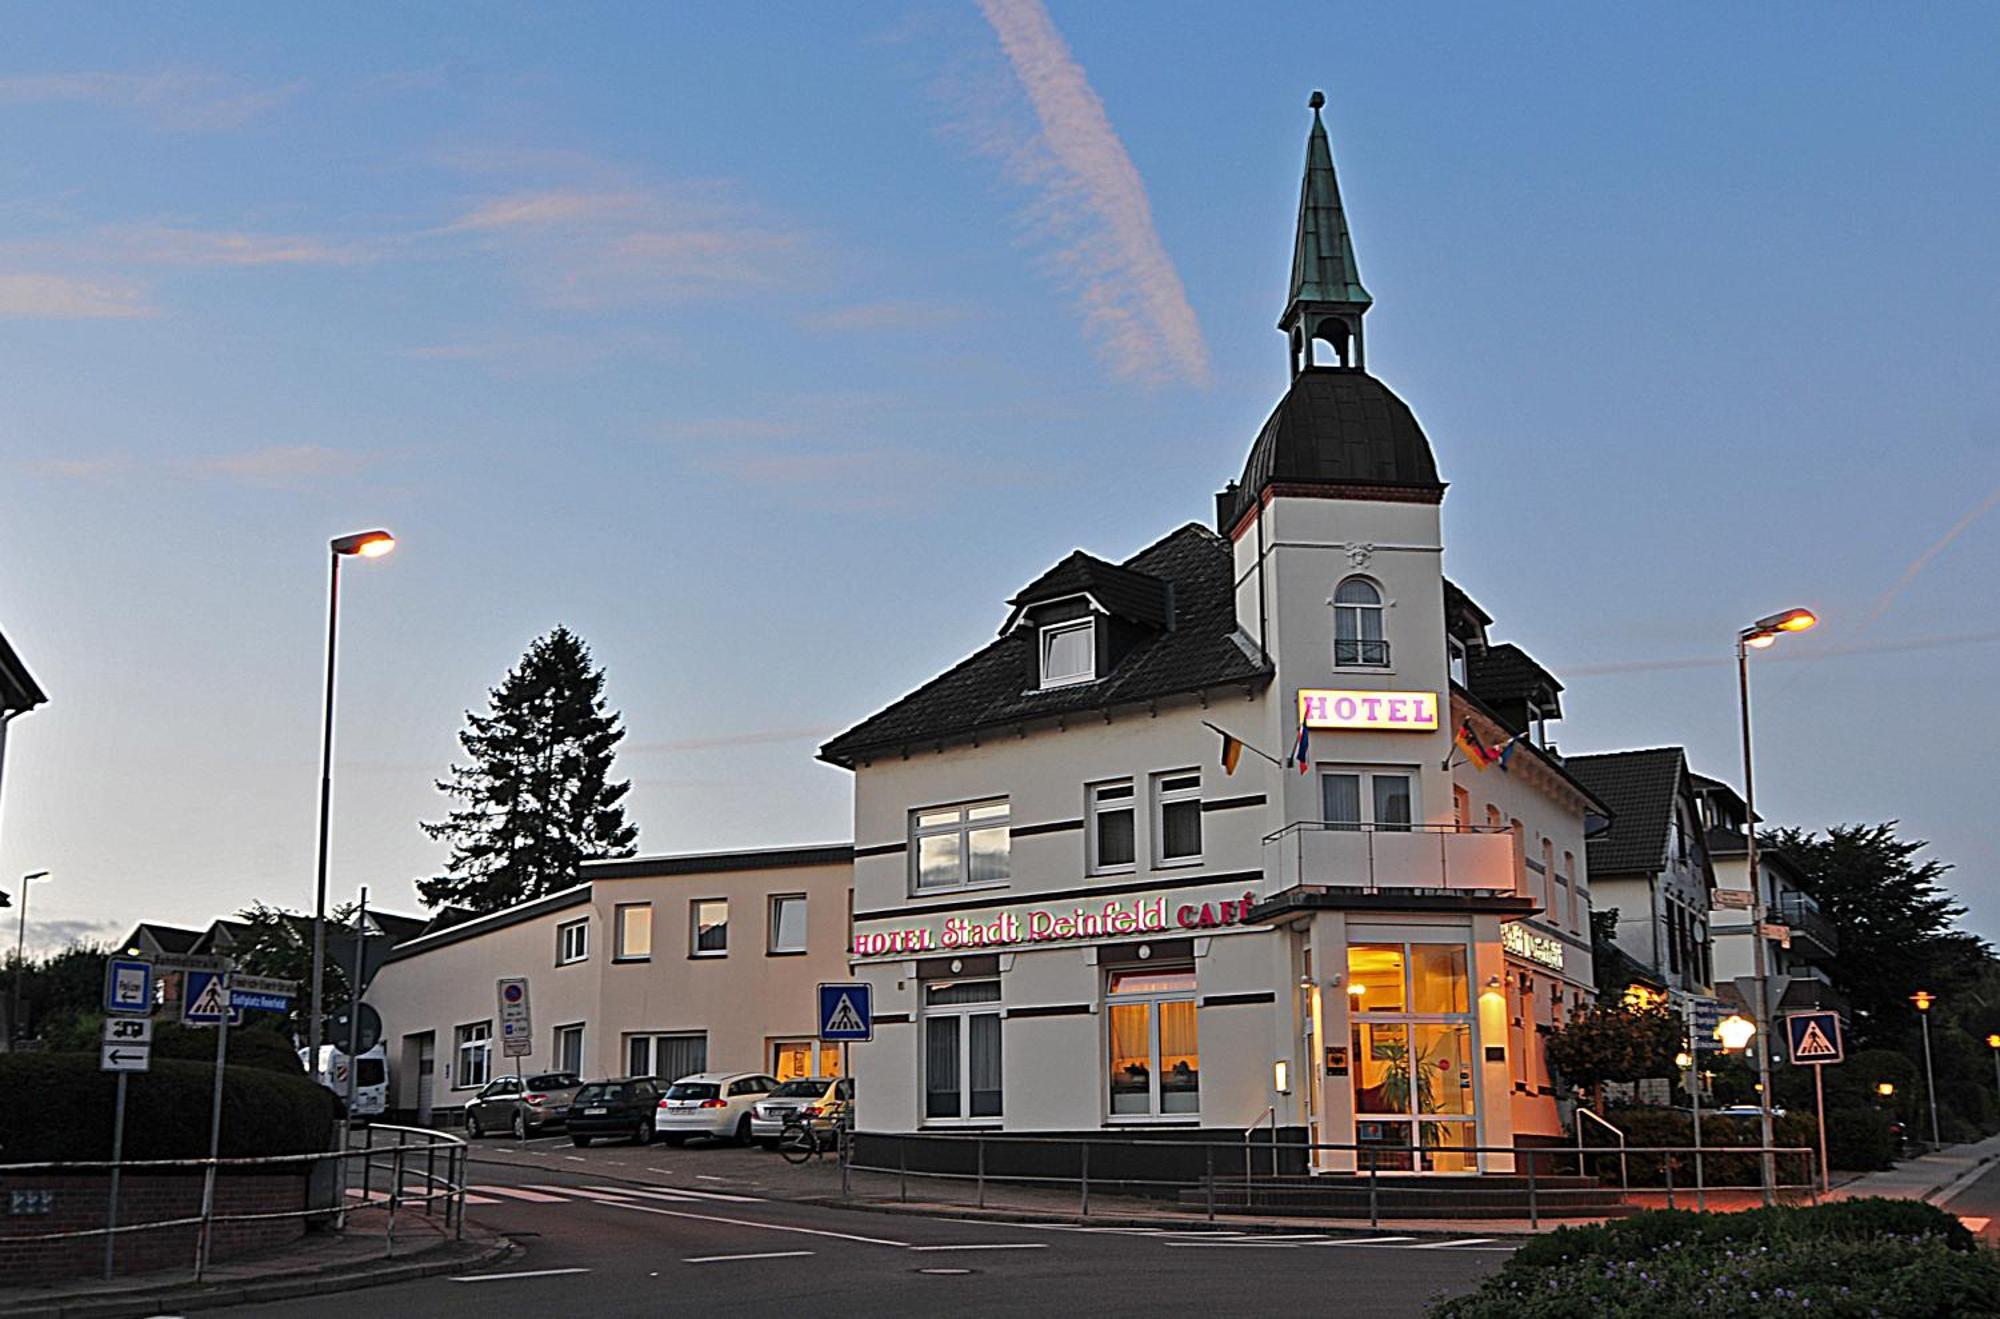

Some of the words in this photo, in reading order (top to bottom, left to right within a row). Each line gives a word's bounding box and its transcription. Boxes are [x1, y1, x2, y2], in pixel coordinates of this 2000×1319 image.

[1303, 696, 1433, 723] HOTEL
[854, 927, 936, 955] HOTEL
[941, 911, 1022, 948] Stadt
[1027, 897, 1168, 941] Reinfeld
